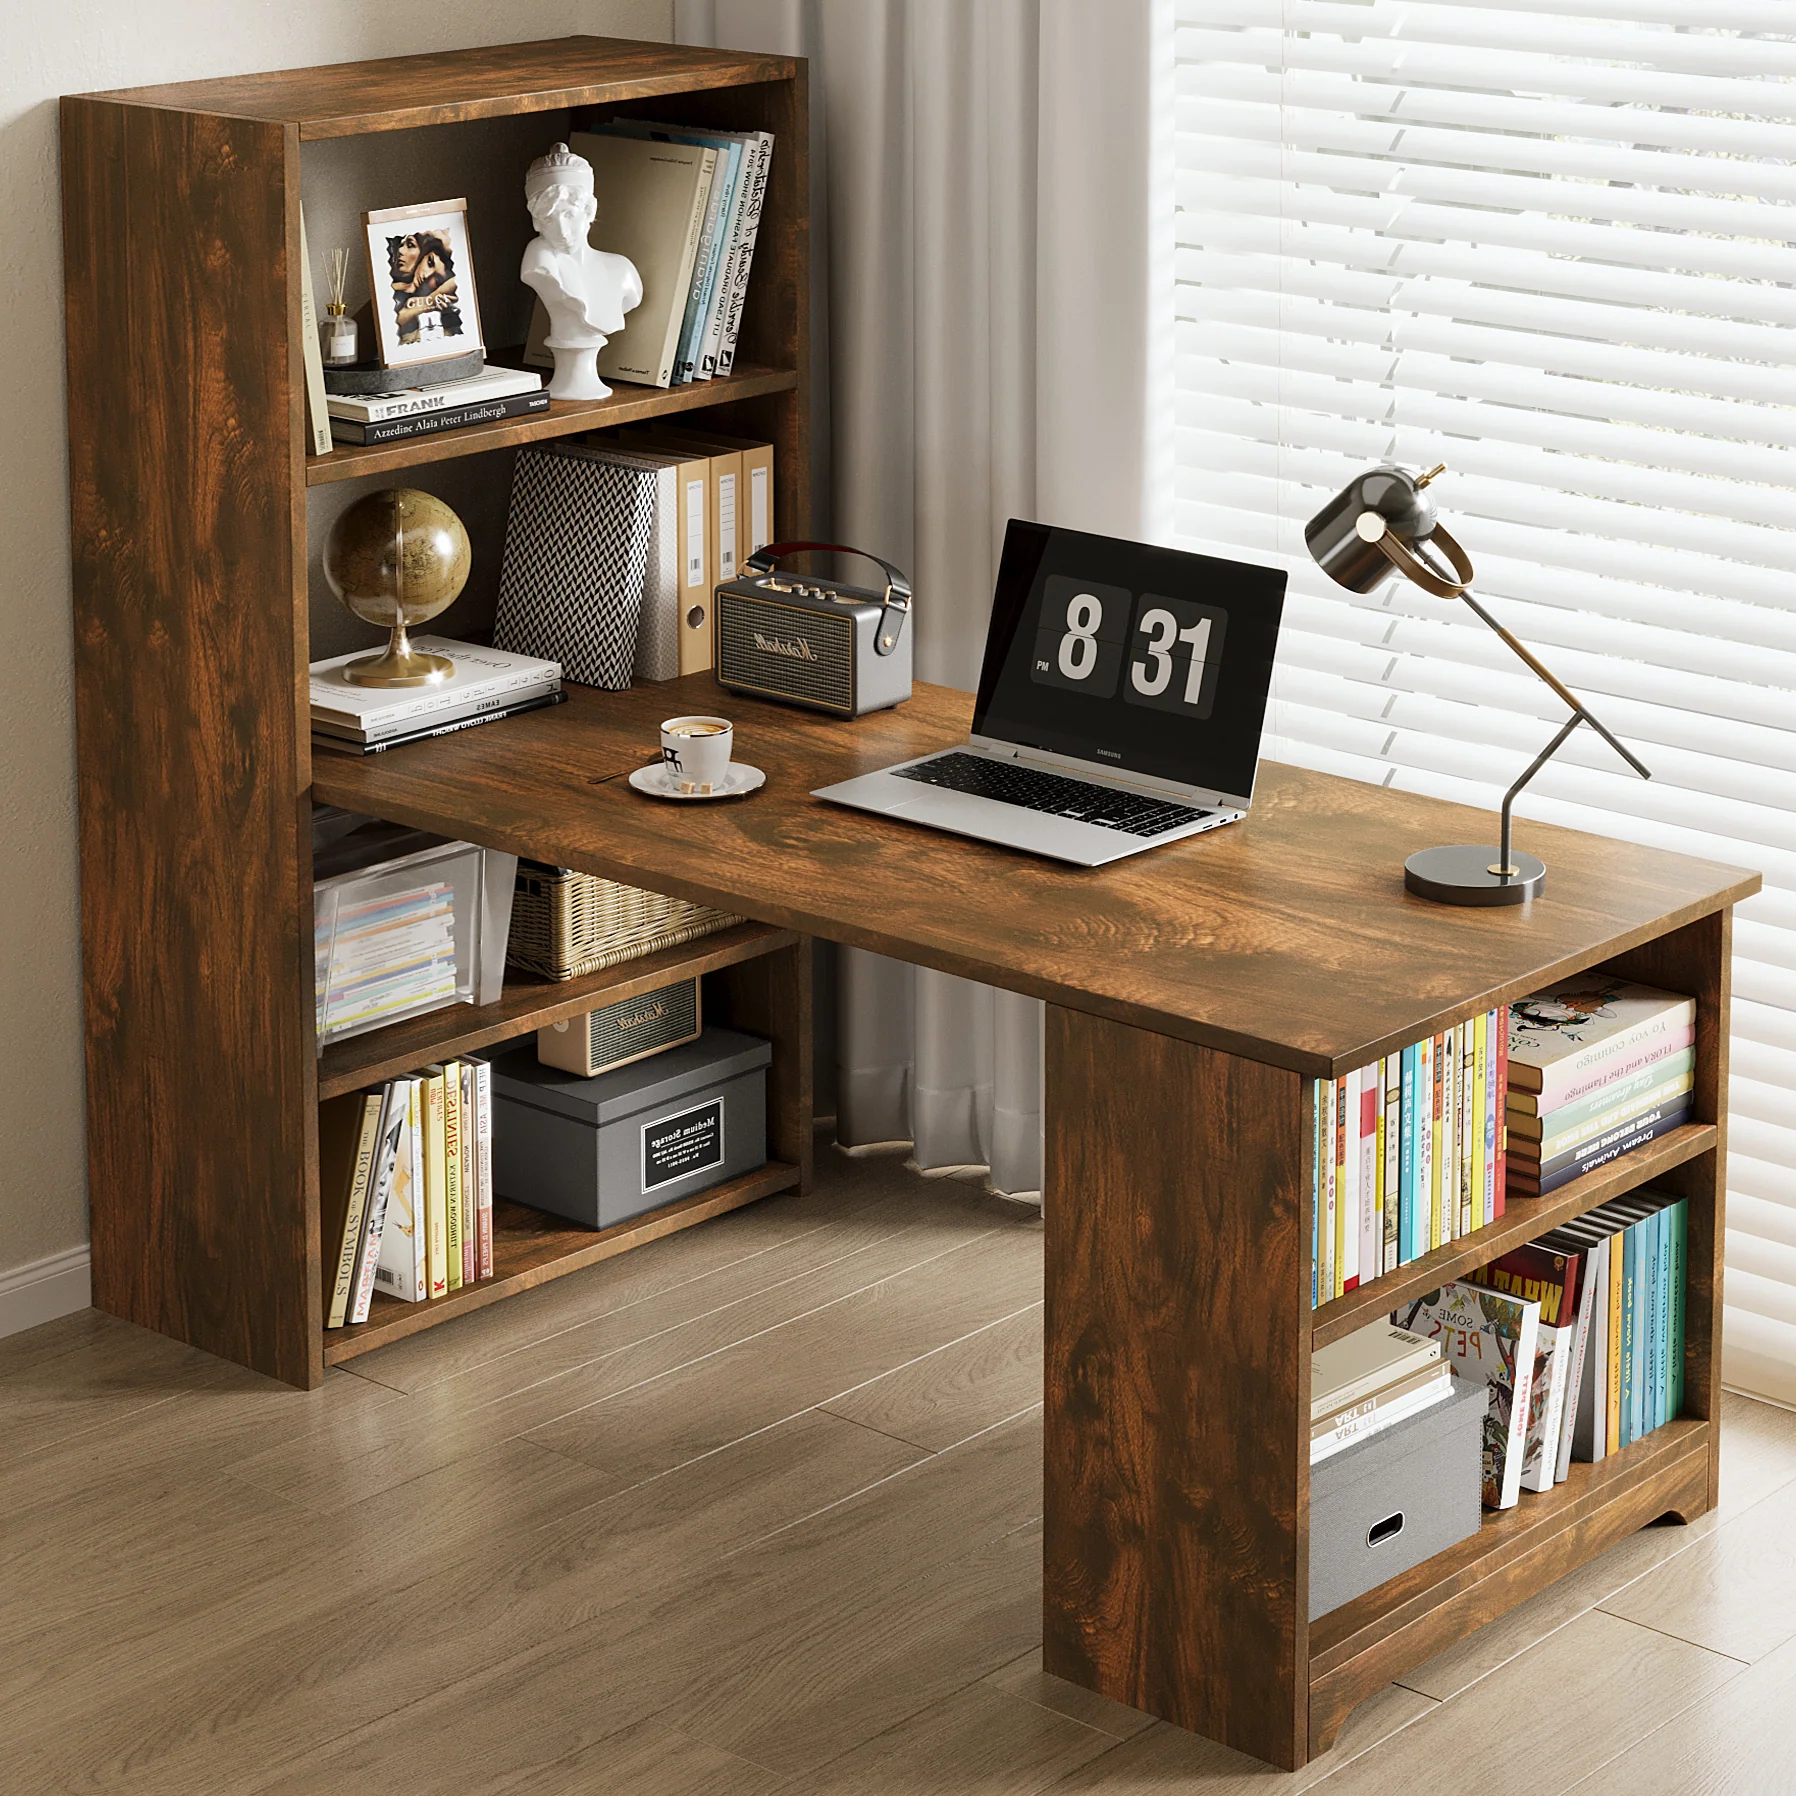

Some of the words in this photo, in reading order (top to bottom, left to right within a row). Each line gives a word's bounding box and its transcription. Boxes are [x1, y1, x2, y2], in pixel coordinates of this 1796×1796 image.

[386, 396, 445, 417] FRANK
[373, 424, 413, 439] Azzedine
[415, 418, 438, 431] Alaïa
[440, 415, 462, 427] Peter
[464, 405, 506, 422] Lindbergh
[529, 399, 548, 407] TASCHEN
[1058, 593, 1103, 681] 8
[1131, 608, 1212, 704] 31
[1036, 659, 1050, 672] PM
[1096, 748, 1122, 760] SAMSUNG
[1652, 1021, 1666, 1034] Yo
[1627, 1031, 1649, 1046] voy
[1576, 1041, 1625, 1070] conmigo
[1643, 1044, 1672, 1064] FLORA
[1609, 1068, 1624, 1080] the
[1625, 1057, 1642, 1073] and
[1564, 1075, 1607, 1101] Flamingo
[1622, 1130, 1653, 1151] Dream
[1574, 1142, 1599, 1161] HERE
[1580, 1146, 1620, 1173] Animals
[353, 1151, 370, 1197] BOOK
[336, 1215, 360, 1297] SYMBOLS
